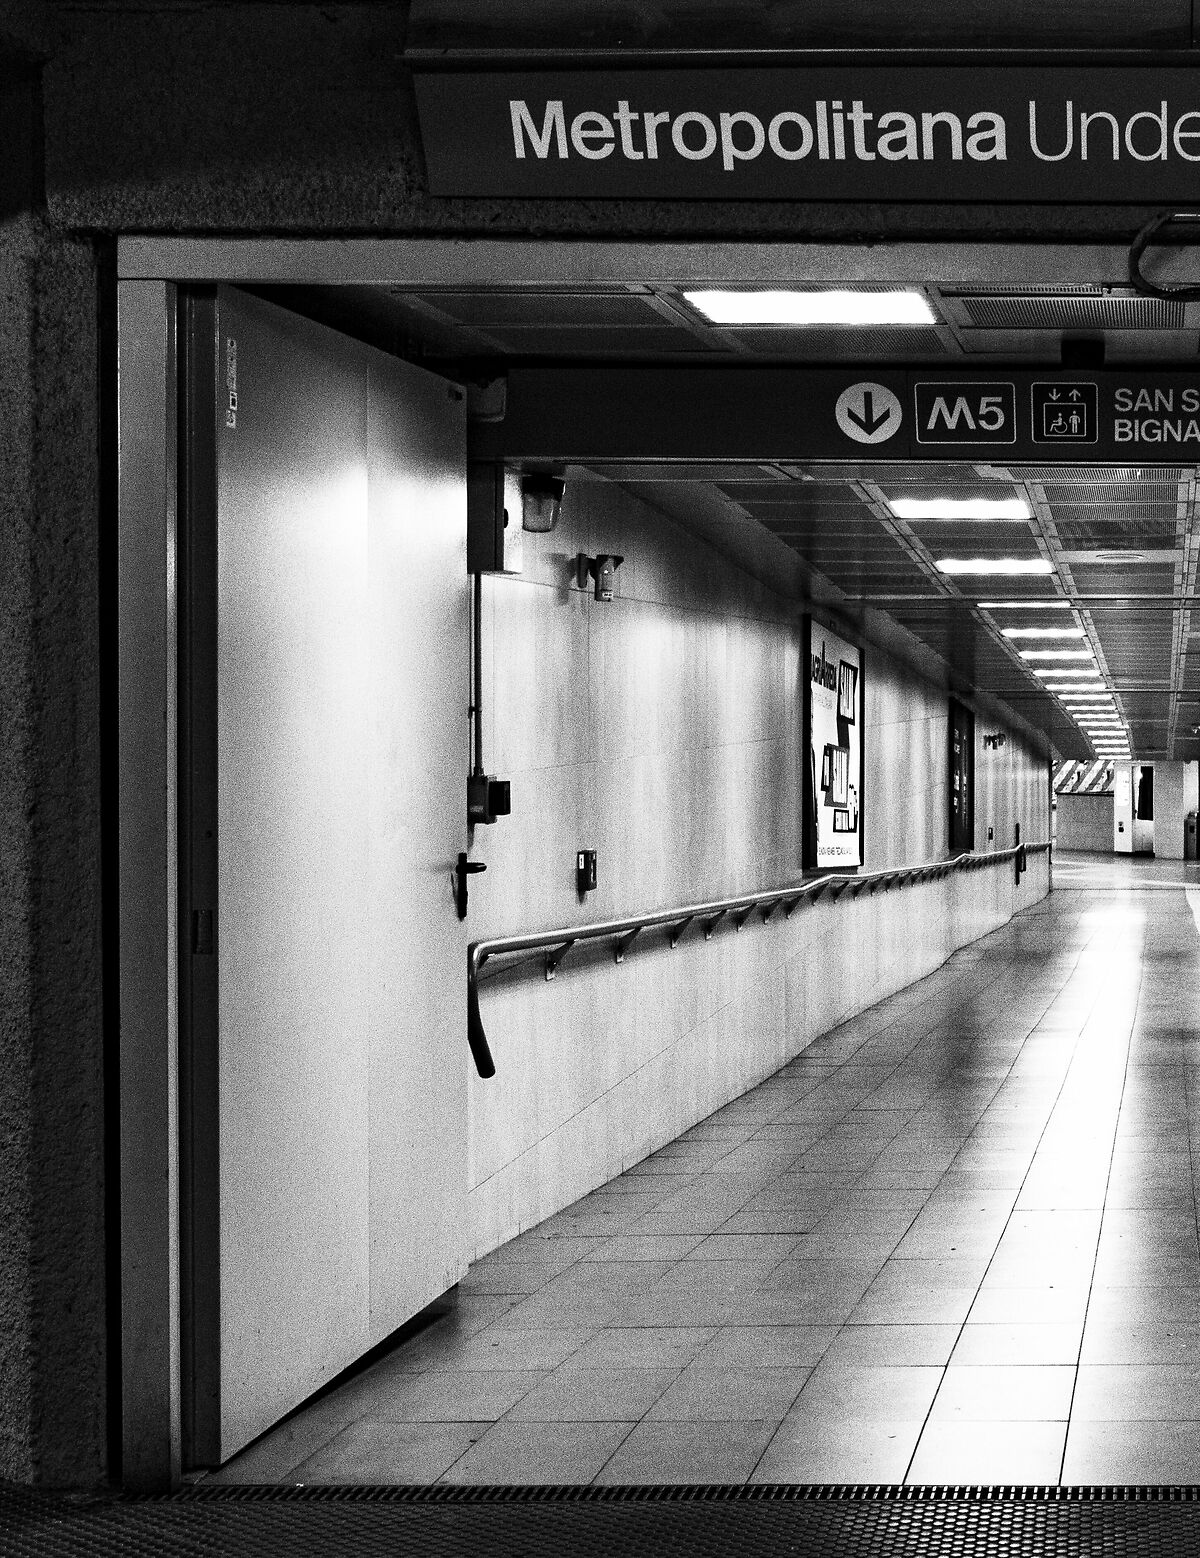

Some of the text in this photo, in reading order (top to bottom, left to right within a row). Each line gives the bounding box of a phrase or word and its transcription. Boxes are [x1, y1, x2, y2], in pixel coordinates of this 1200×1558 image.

[509, 100, 1007, 171] Metropolitana
[926, 396, 1006, 431] M5
[1114, 388, 1174, 412] SAN
